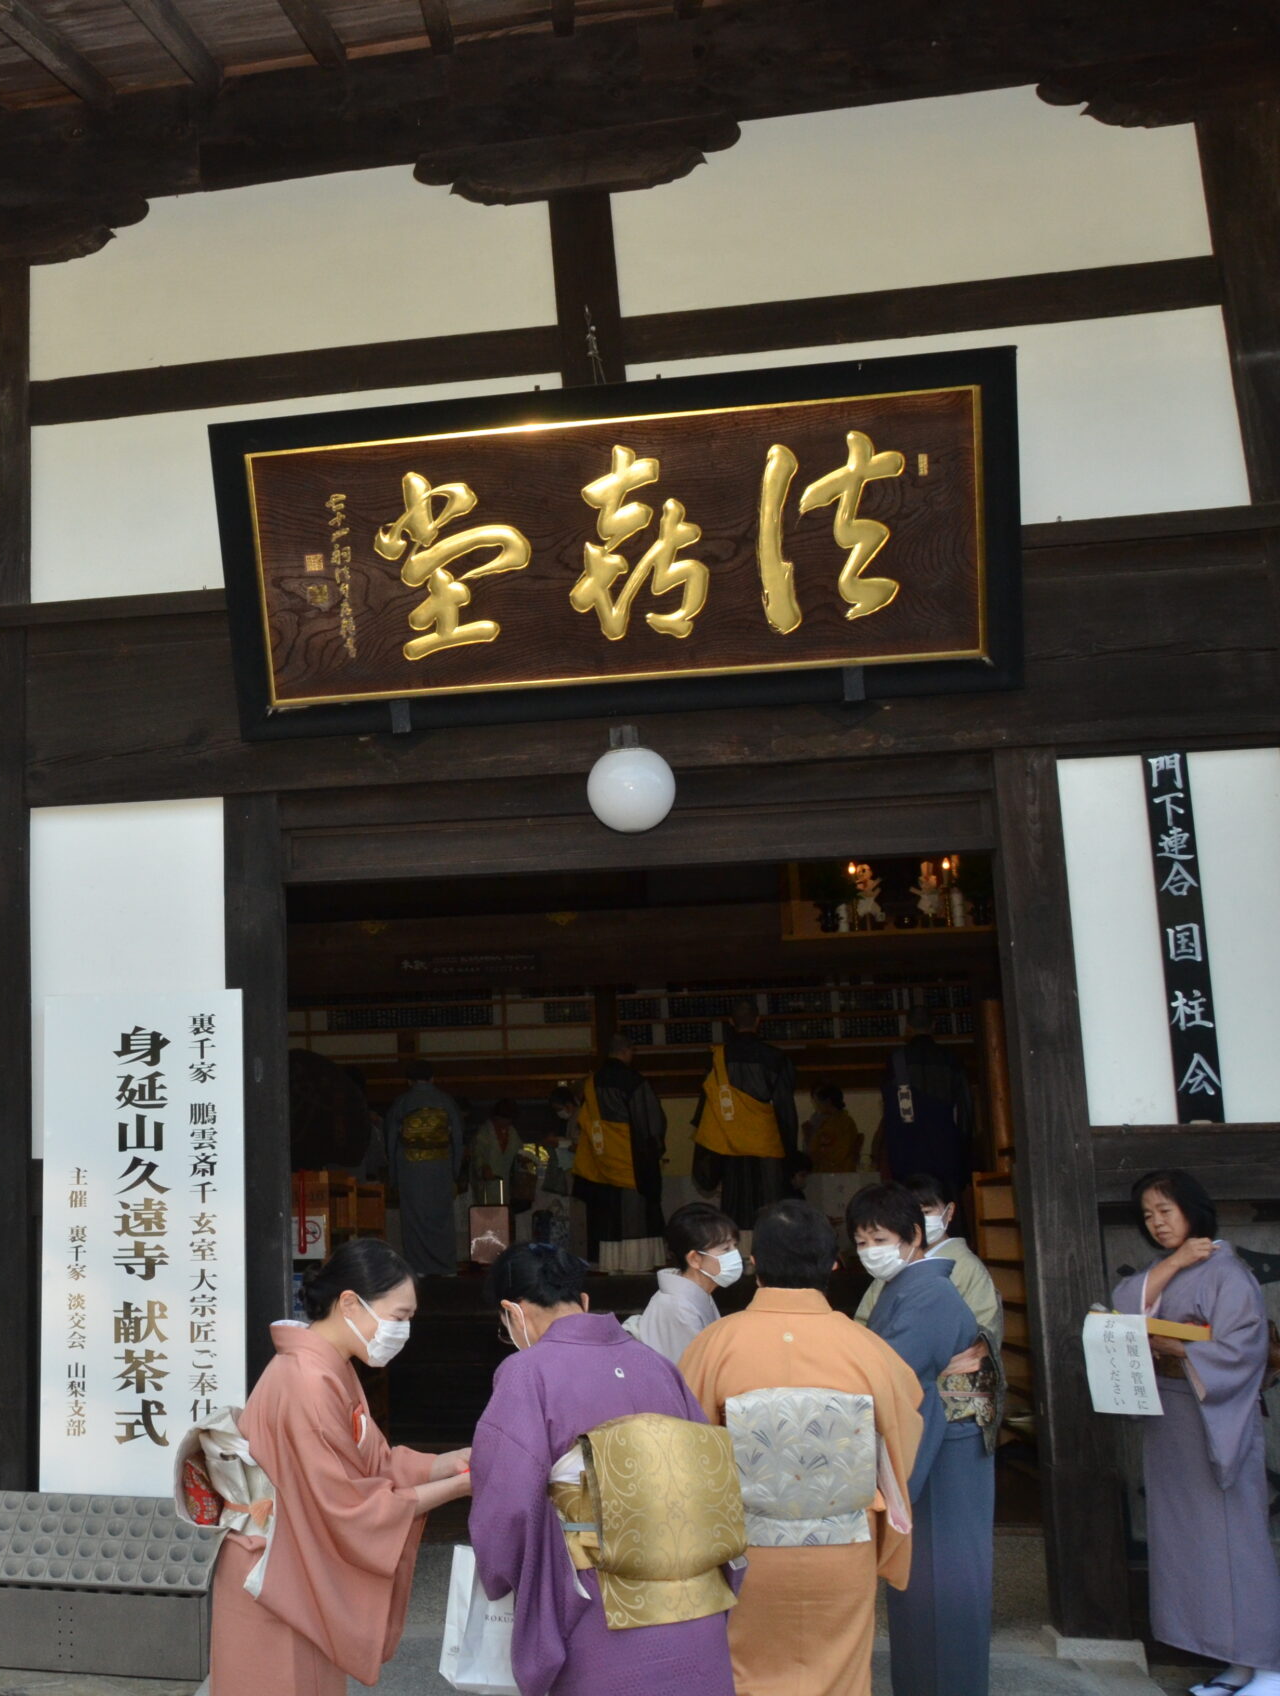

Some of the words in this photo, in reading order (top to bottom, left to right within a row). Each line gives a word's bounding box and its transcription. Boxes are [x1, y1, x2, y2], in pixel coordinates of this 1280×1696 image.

[187, 1013, 217, 1083] 裏千家
[68, 1166, 89, 1209] 主催
[113, 1025, 171, 1281] 身延山久遠寺
[66, 1226, 88, 1281] 裏千家
[66, 1292, 87, 1350] 淡交会
[66, 1361, 87, 1438] 山梨支部
[113, 1300, 170, 1448] 献茶式
[1103, 1319, 1126, 1407] お使いください
[1125, 1331, 1150, 1411] 草履の管理に
